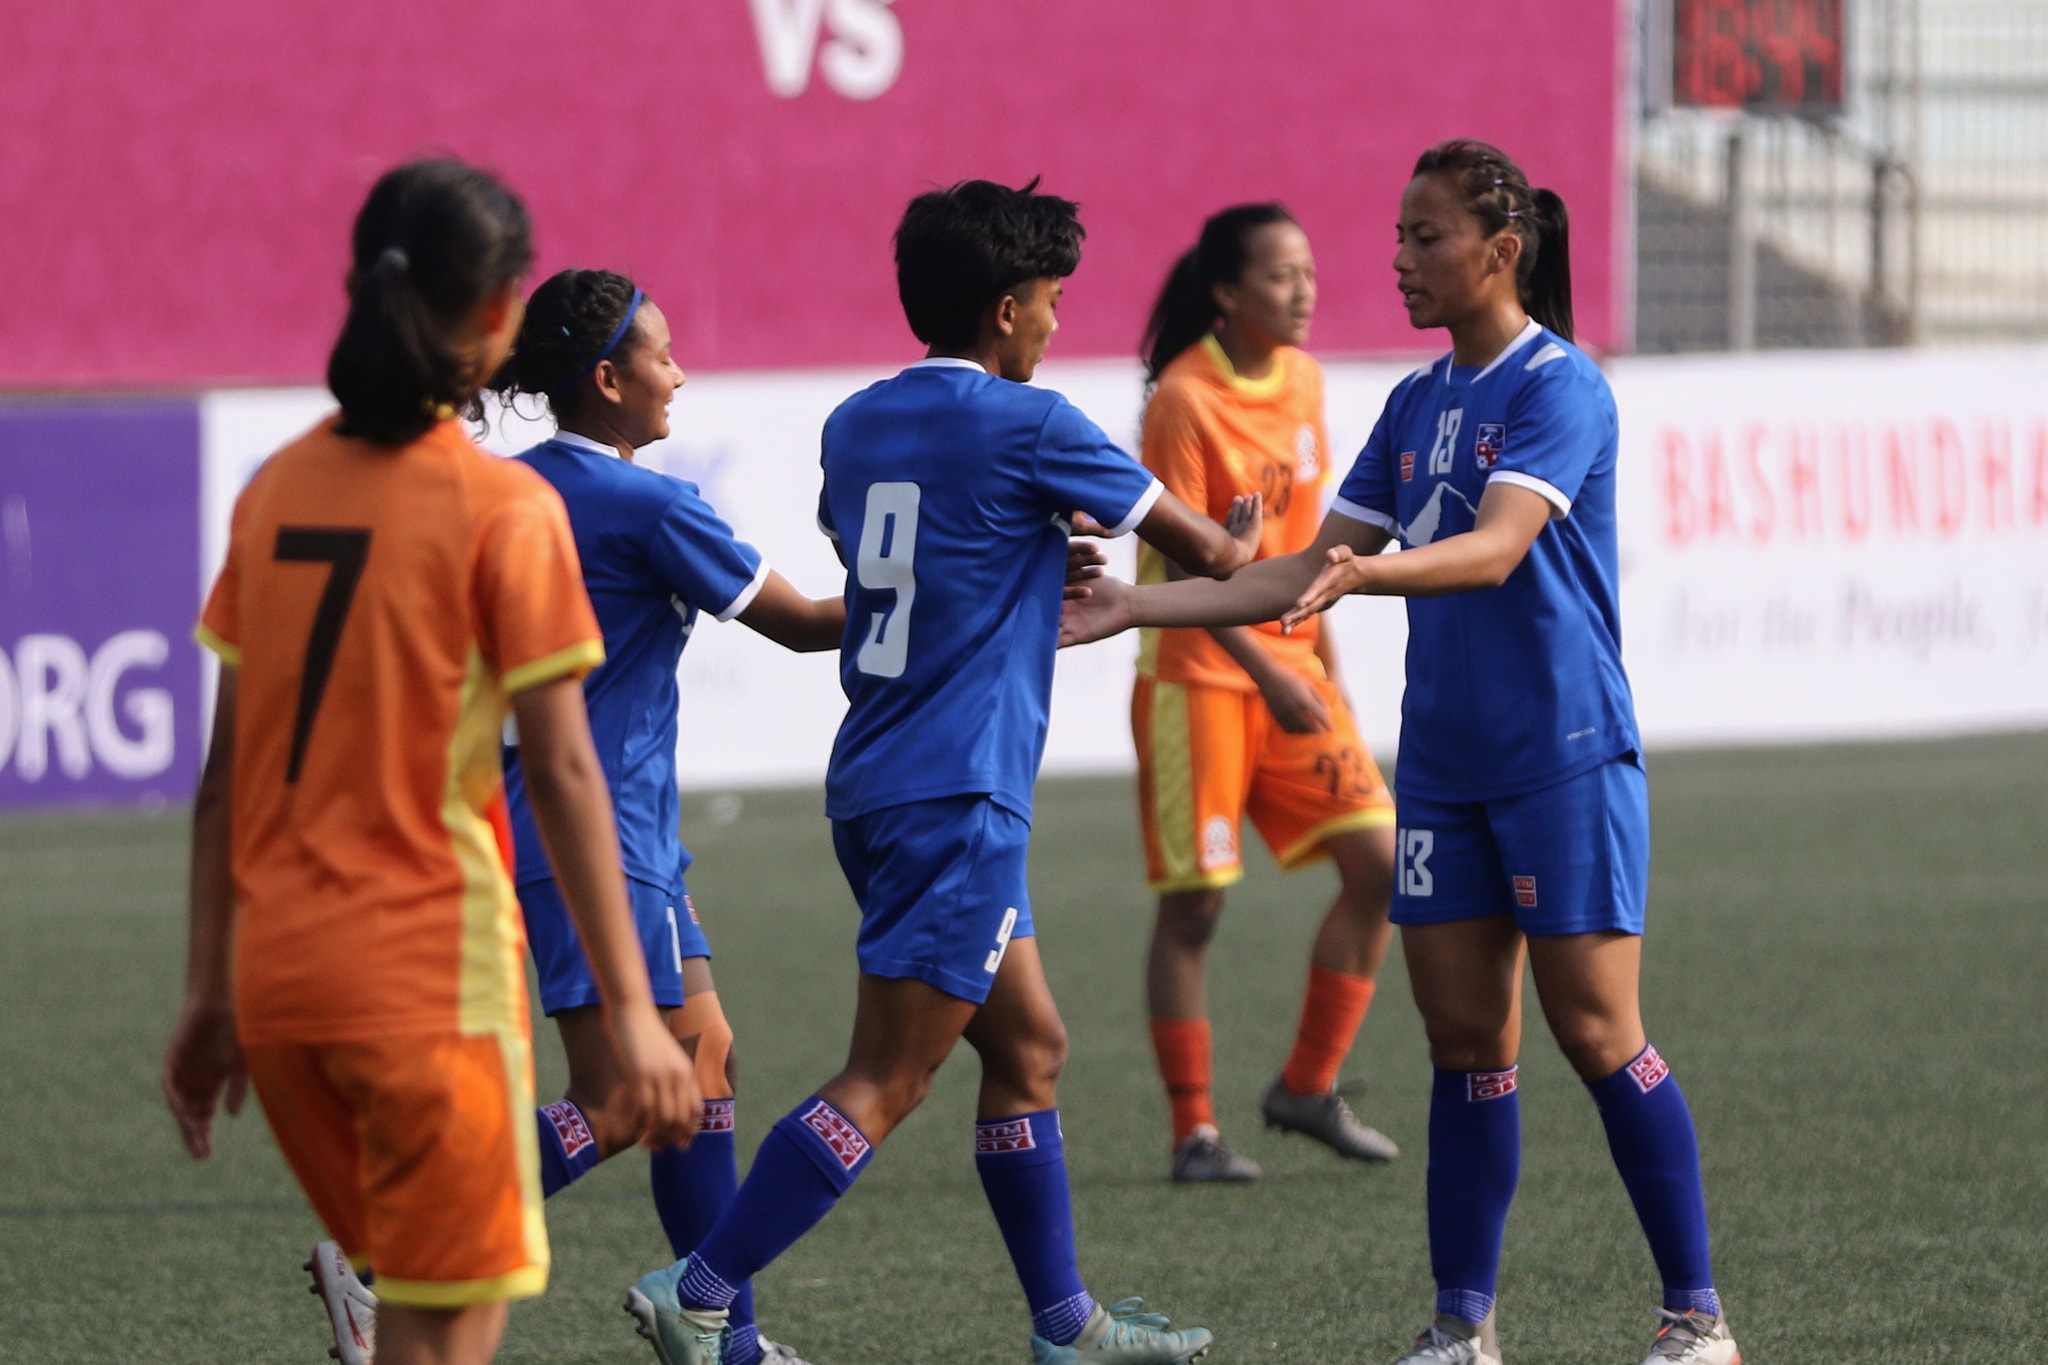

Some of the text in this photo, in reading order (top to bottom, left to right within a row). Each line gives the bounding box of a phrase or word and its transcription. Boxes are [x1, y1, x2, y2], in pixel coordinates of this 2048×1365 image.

[747, 0, 905, 100] VS
[1429, 408, 1464, 475] 13
[857, 482, 921, 678] 9
[273, 525, 374, 785] 7
[984, 907, 1018, 973] 9
[812, 1117, 854, 1156] CTY
[821, 1107, 863, 1151] KTM
[977, 1123, 1022, 1137] KTM
[978, 1138, 1022, 1151] CTY
